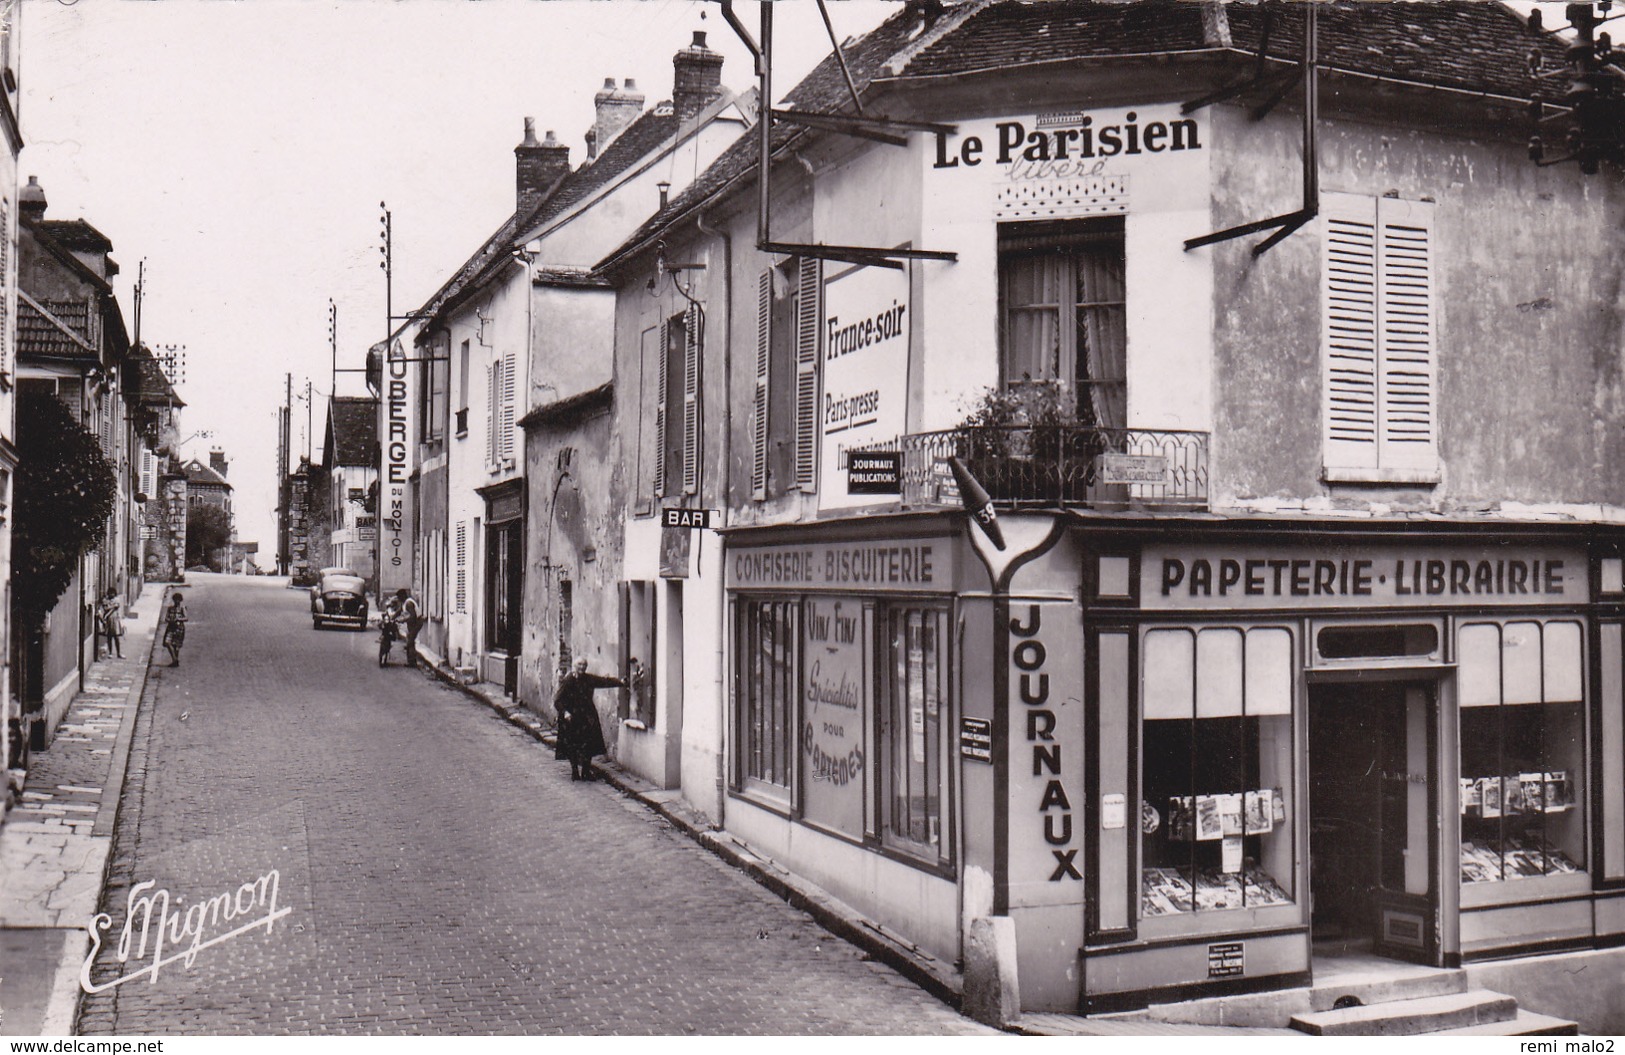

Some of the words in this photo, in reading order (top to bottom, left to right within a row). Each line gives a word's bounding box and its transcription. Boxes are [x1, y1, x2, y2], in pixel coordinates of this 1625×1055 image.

[933, 131, 983, 169] Le
[996, 111, 1202, 165] Parisien
[827, 299, 905, 360] France-soir
[387, 338, 408, 484] AUBERGE
[825, 389, 879, 429] Paris-presse
[850, 473, 896, 483] PUBLICATIONS
[853, 459, 893, 470] JOURNAUX
[391, 488, 403, 497] DU
[391, 500, 403, 566] MONTOIS
[668, 511, 703, 526] BAR
[735, 551, 813, 582] CONFISERIE
[825, 546, 932, 582] BISCUITERIE
[1162, 559, 1372, 596] PAPETERIE
[1396, 559, 1564, 594] LIBRAIRIE
[823, 721, 844, 737] POUR
[1009, 604, 1083, 882] JOURNAUX
